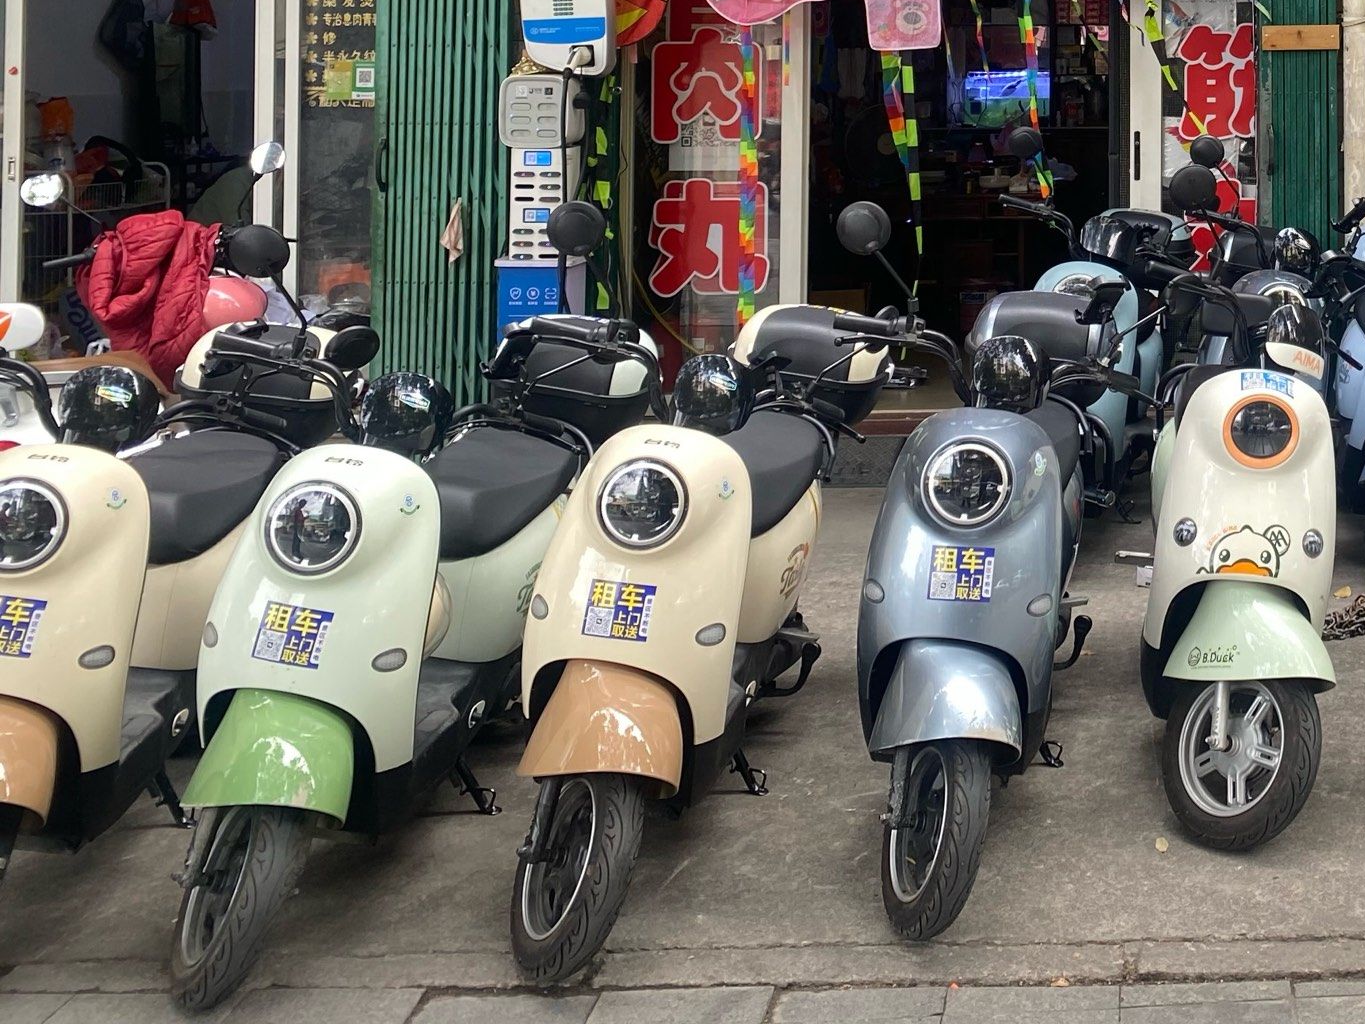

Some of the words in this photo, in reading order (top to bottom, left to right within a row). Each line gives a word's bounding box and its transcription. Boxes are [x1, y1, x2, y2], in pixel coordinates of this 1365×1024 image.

[322, 13, 377, 27] 专治息肉青
[1293, 350, 1321, 374] AIMA
[934, 548, 984, 574] 租车
[957, 574, 983, 588] 上门
[592, 581, 645, 610] 租车
[956, 587, 981, 600] 取送
[264, 604, 322, 637] 租车
[613, 610, 641, 626] 上门
[611, 624, 638, 638] 取送
[285, 636, 315, 652] 上门
[281, 649, 310, 665] 取送
